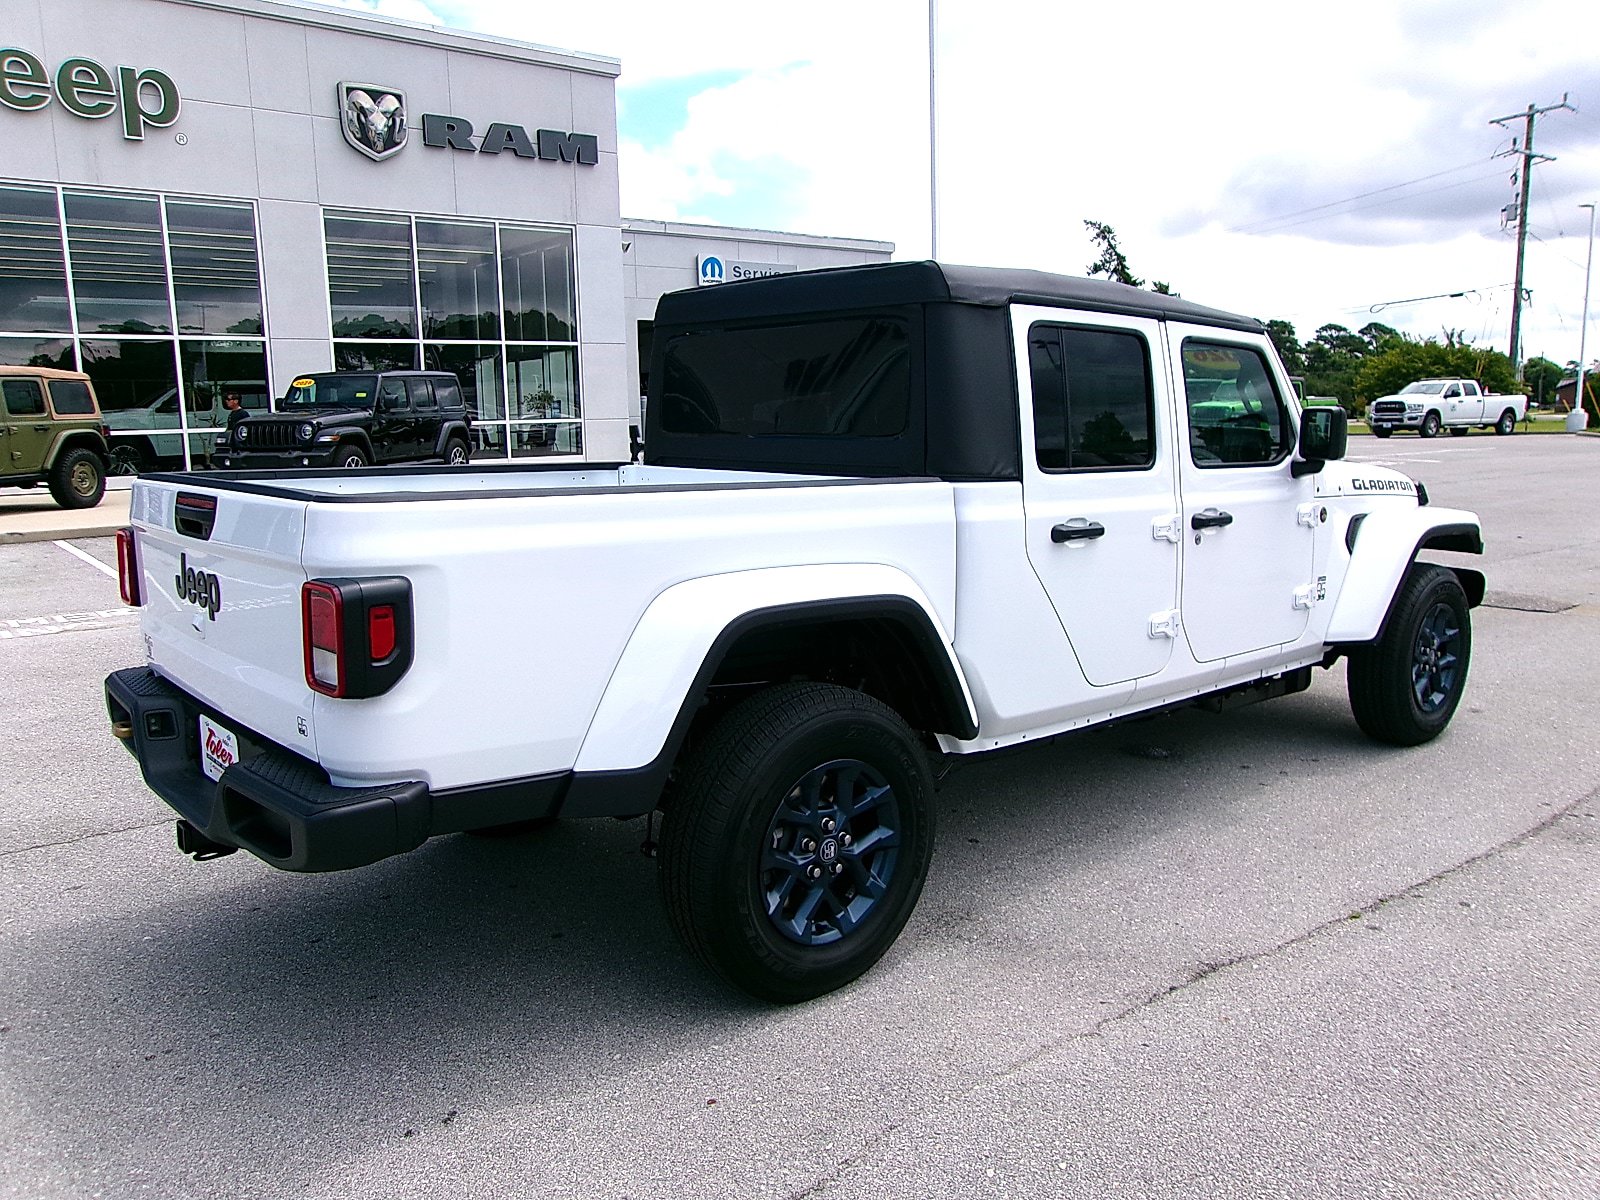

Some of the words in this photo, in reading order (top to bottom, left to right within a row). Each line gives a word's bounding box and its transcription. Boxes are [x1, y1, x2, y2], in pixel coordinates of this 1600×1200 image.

[422, 113, 598, 165] RAM
[1351, 478, 1413, 491] GLADIATOR
[175, 552, 221, 621] Jeep
[205, 726, 235, 766] Toler
